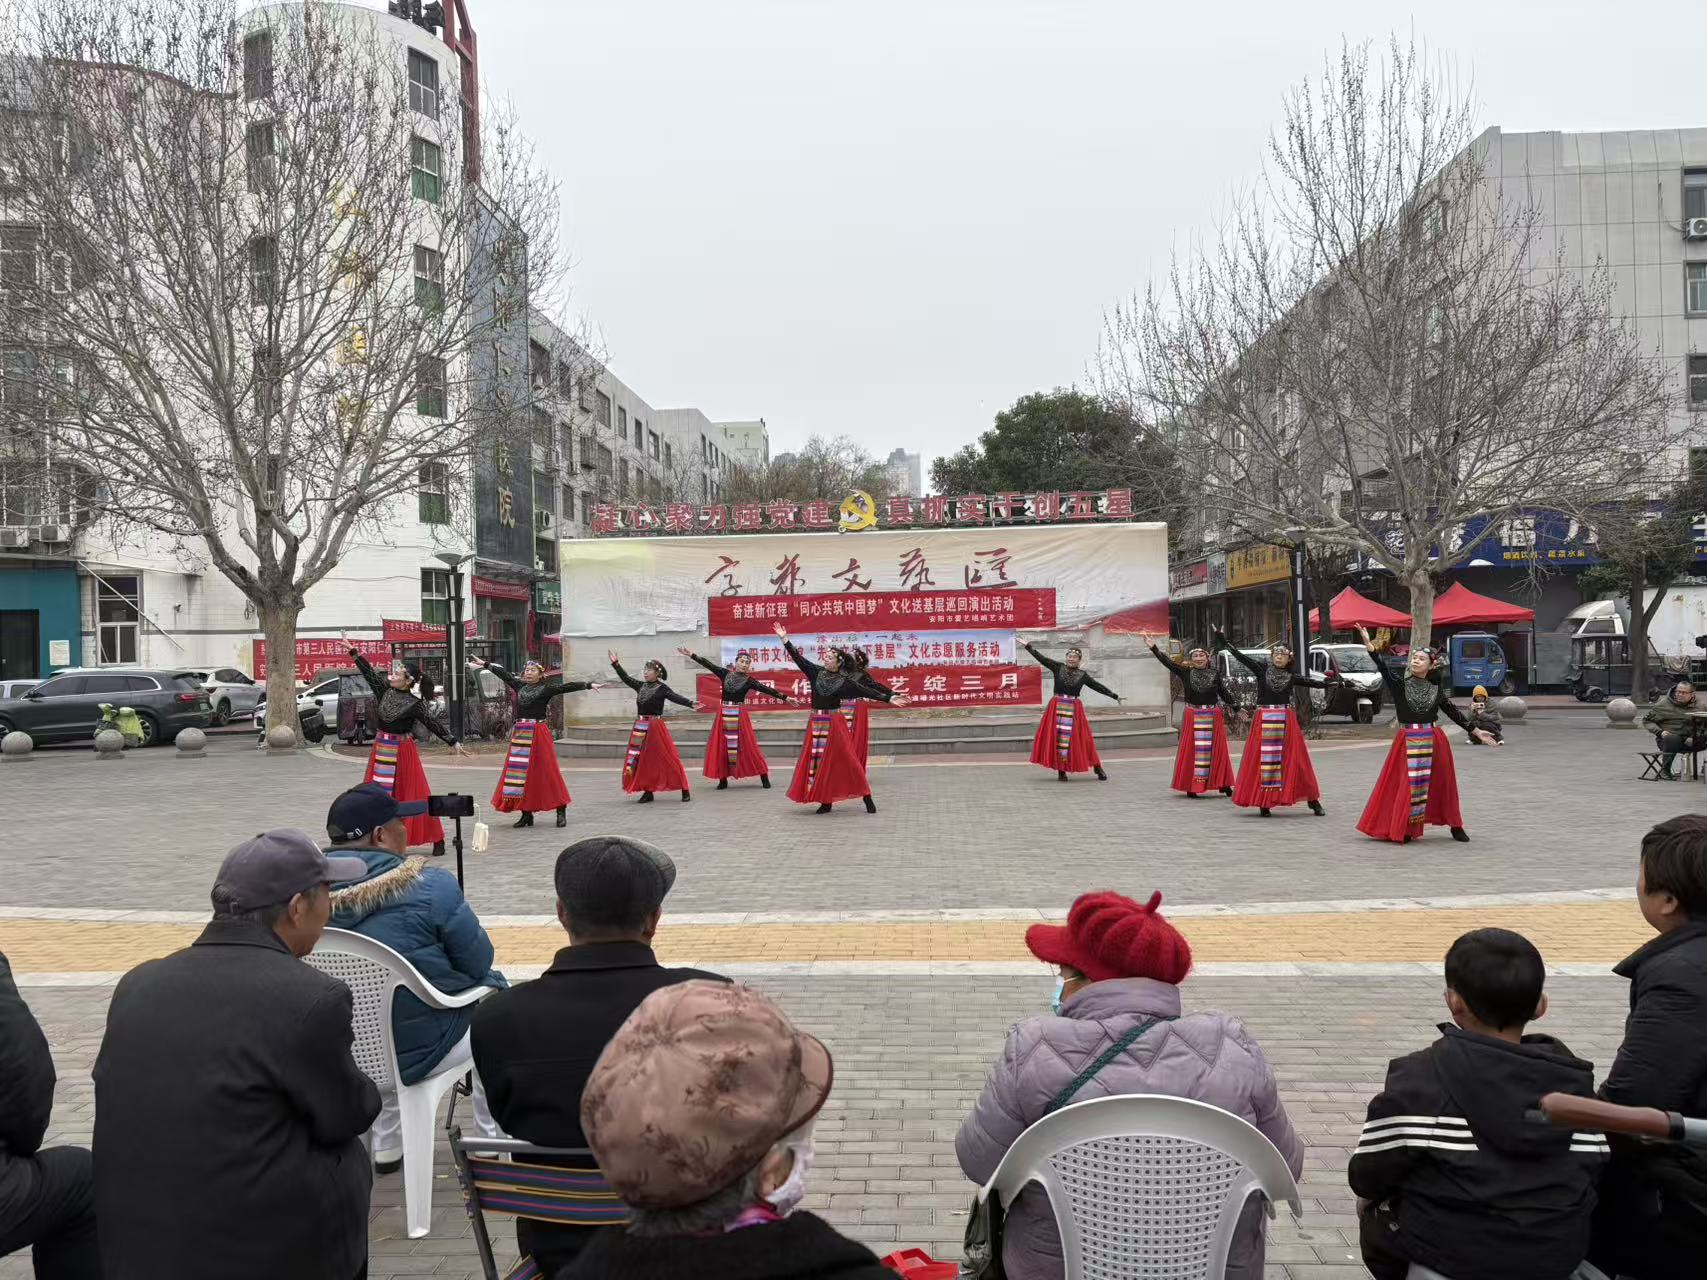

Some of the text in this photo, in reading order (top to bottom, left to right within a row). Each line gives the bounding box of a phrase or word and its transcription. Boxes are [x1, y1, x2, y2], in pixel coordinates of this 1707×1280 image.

[590, 488, 1136, 533] 凝心聚力强党建 真抓实干创五星
[887, 673, 1018, 693] 艺绽三月
